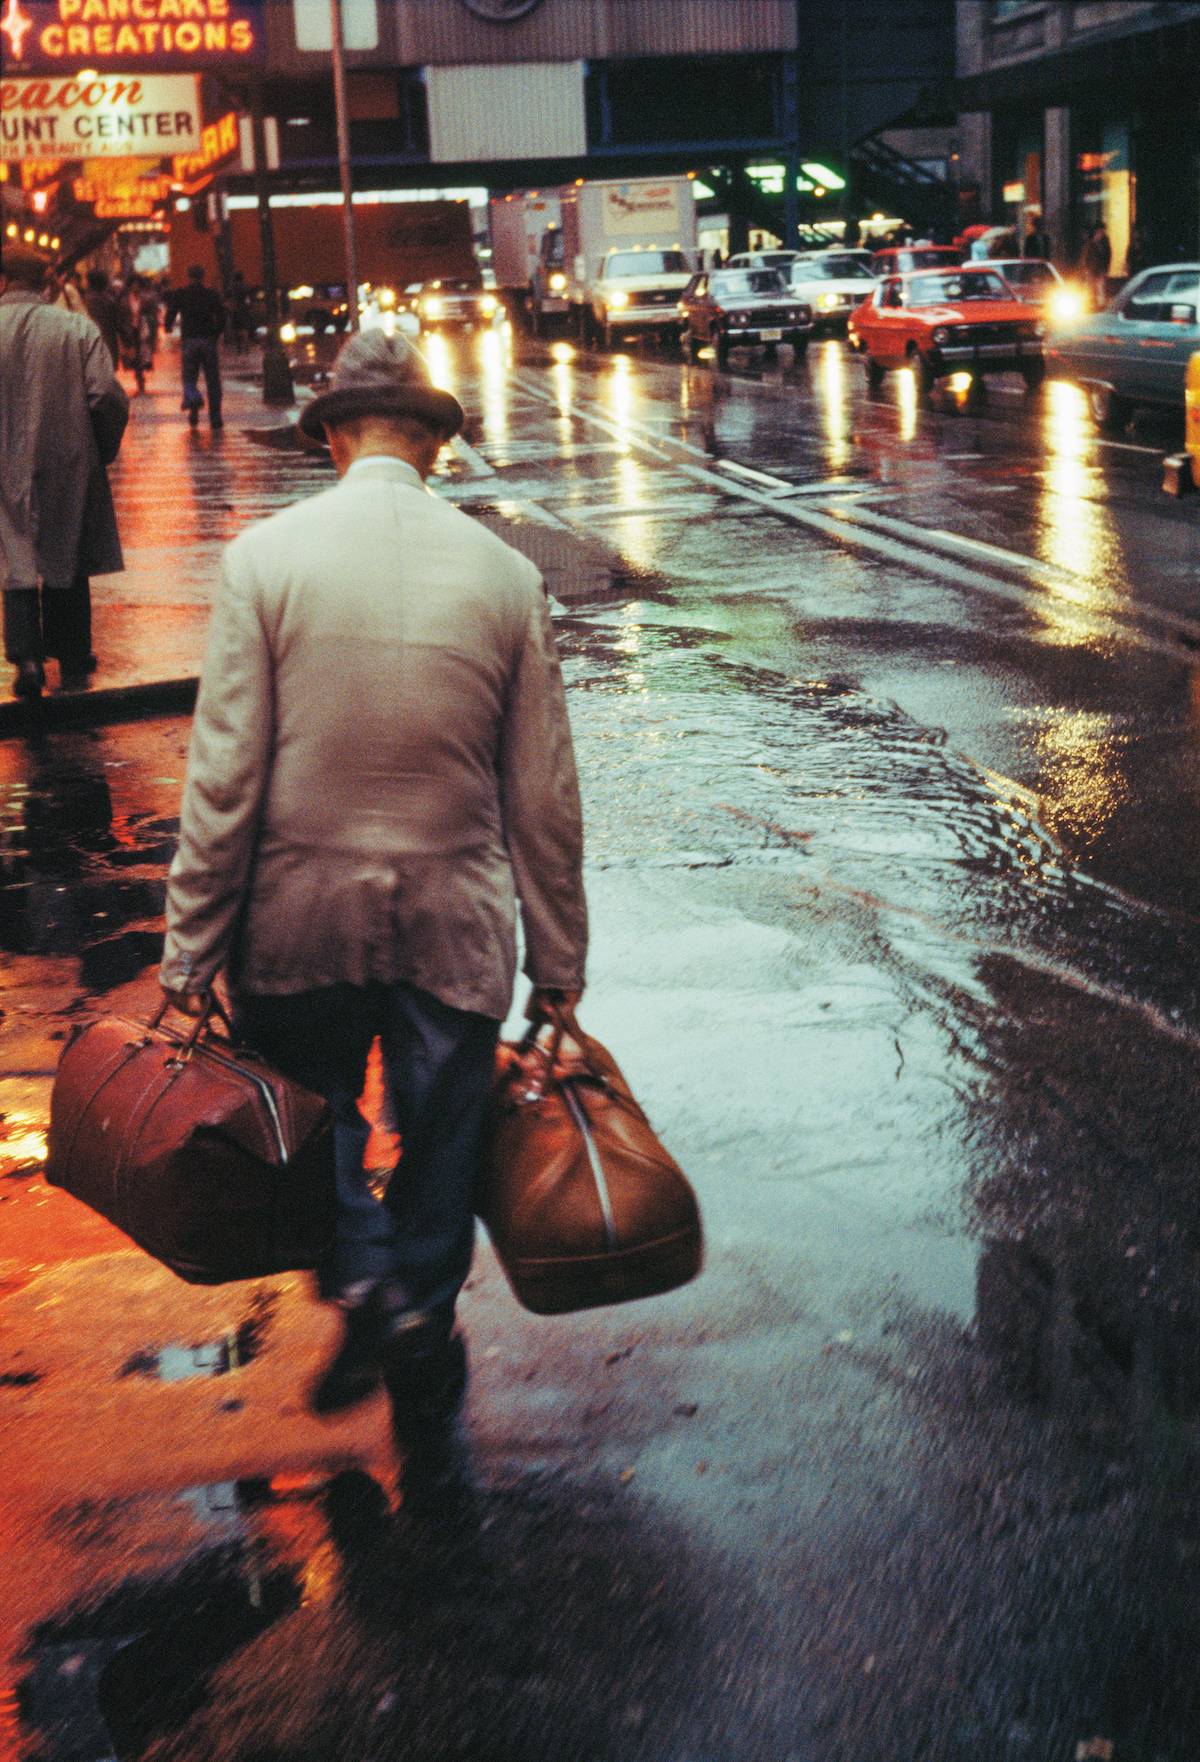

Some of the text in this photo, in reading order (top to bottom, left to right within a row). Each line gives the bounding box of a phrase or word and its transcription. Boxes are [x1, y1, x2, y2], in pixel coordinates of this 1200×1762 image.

[58, 0, 229, 20] PANCAKE
[40, 19, 253, 56] CREATIONS
[74, 111, 193, 138] CENTER
